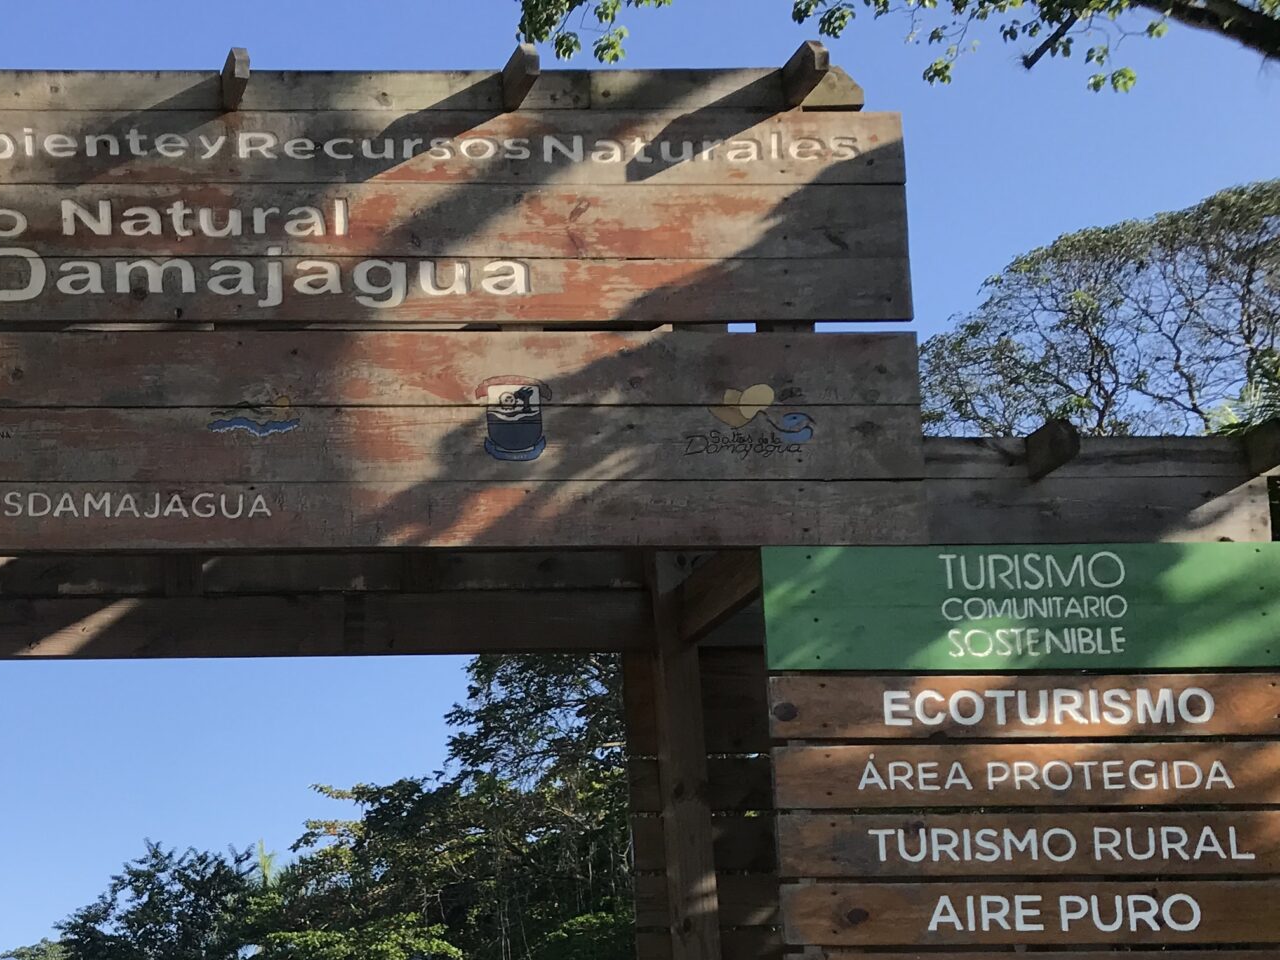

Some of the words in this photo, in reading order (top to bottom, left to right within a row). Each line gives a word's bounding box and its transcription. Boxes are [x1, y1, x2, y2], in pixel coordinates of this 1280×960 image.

[238, 132, 531, 161] Recursos
[543, 132, 861, 165] Naturales
[61, 198, 349, 238] Natural
[939, 551, 1126, 591] TURISMO
[941, 594, 1128, 622] COMUNITARIO
[948, 626, 1126, 659] SOSTENIBLE
[883, 686, 1215, 726] ECOTURISMO
[857, 753, 973, 792] ÁREA
[986, 759, 1236, 791] PROTEGIDA
[867, 828, 1077, 863] TURISMO
[1093, 826, 1257, 861] RURAL
[927, 895, 1045, 933] AIRE
[1058, 892, 1201, 932] PURO
